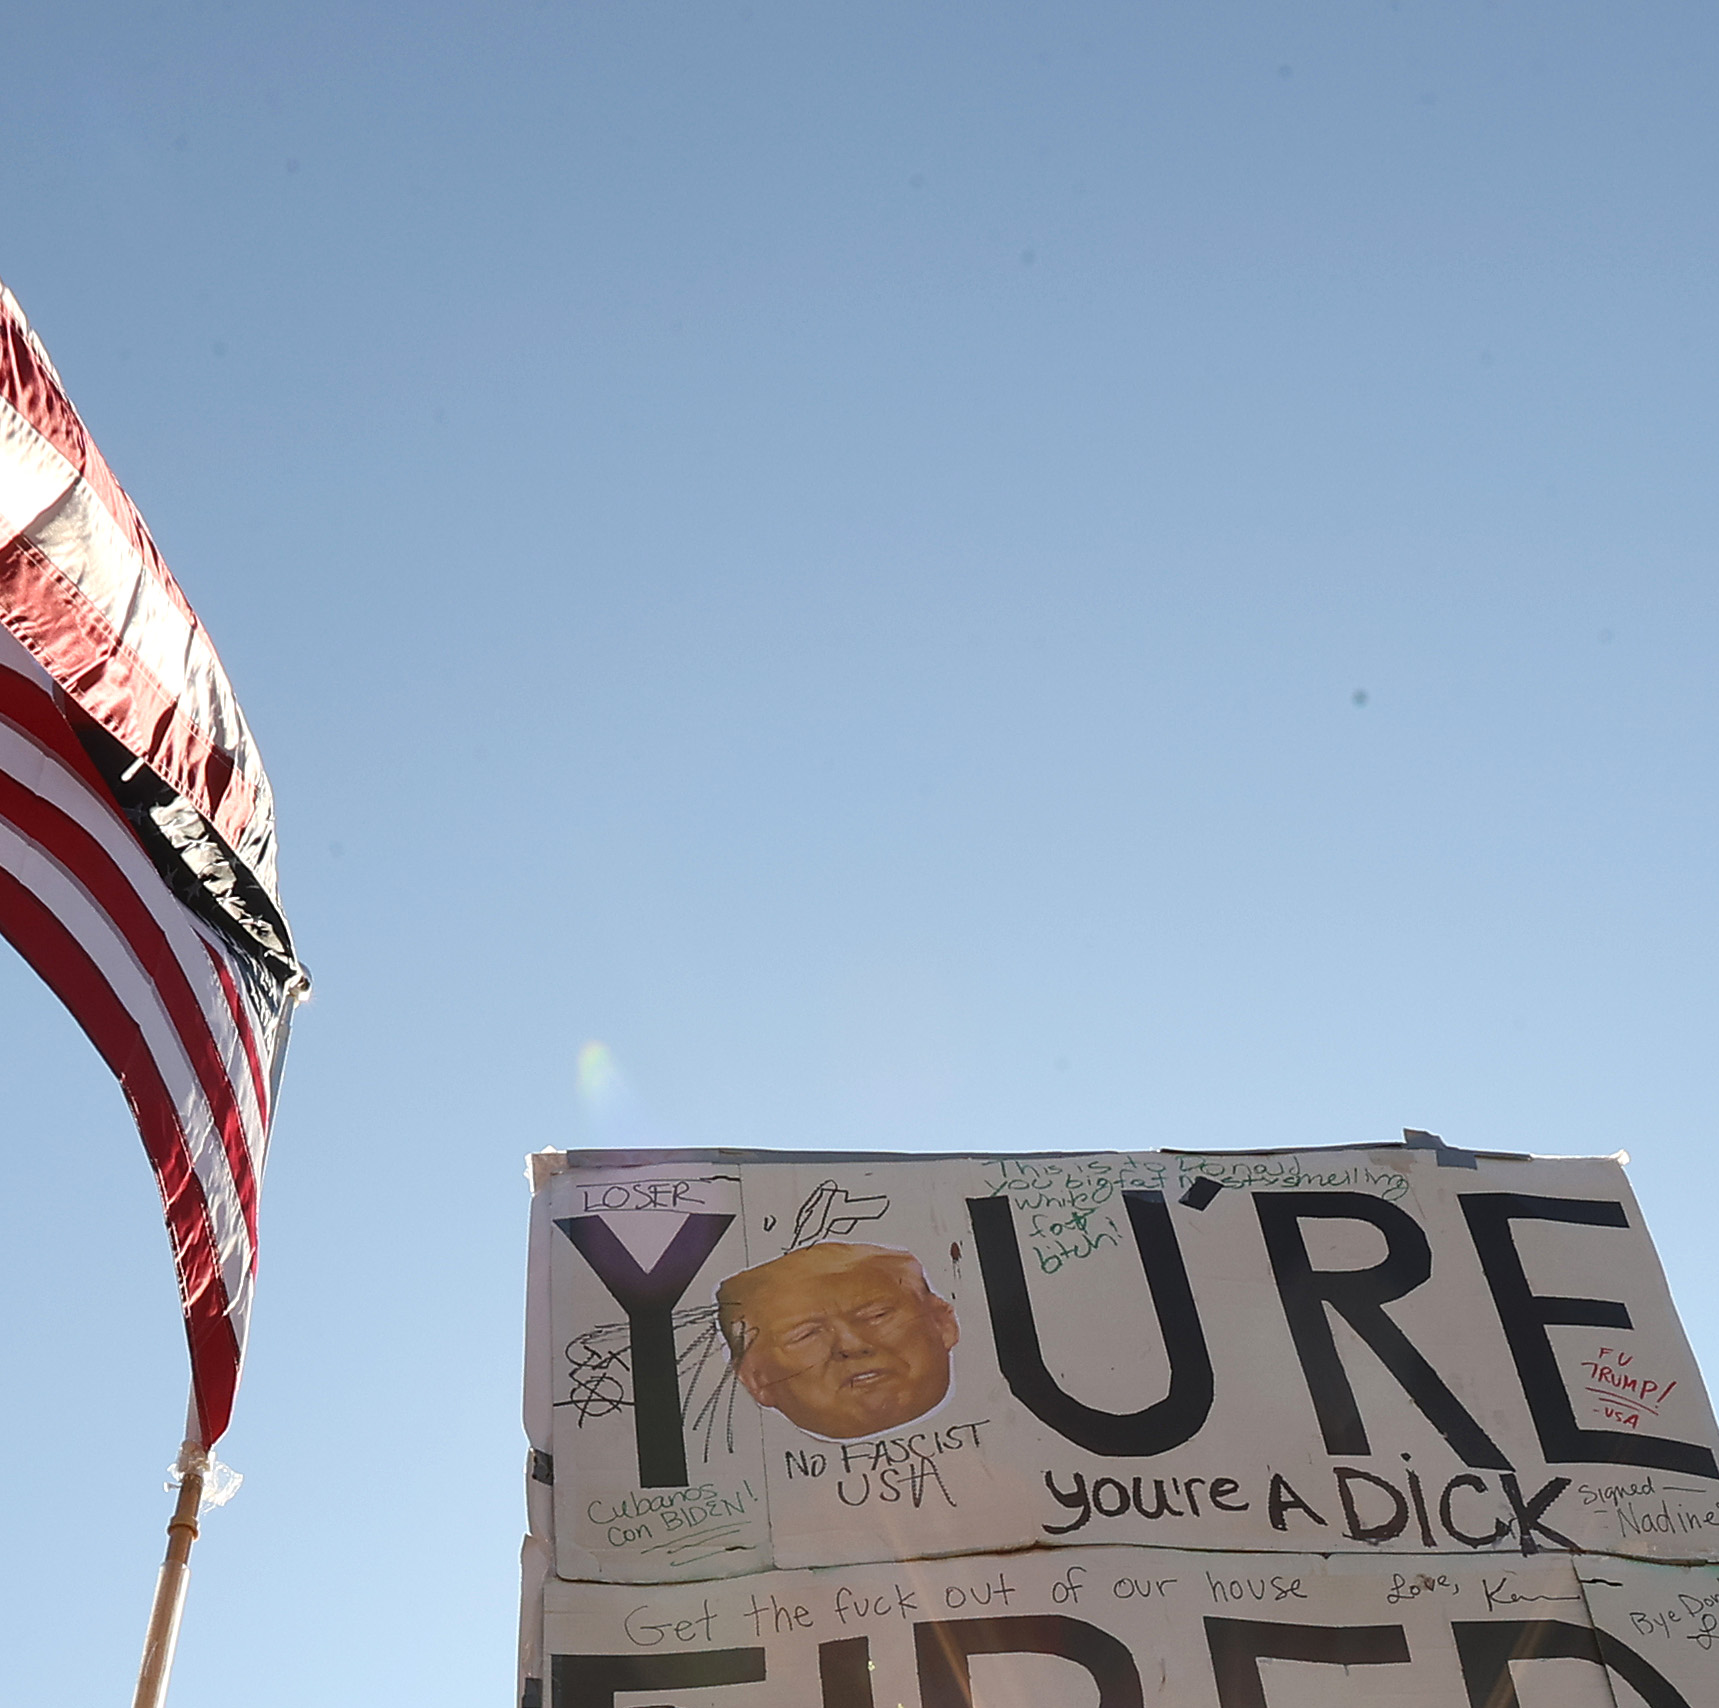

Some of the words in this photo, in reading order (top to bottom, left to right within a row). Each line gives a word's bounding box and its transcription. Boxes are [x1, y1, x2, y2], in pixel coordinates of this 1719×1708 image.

[581, 1178, 704, 1213] LOSER
[786, 1449, 826, 1479] NO
[842, 1419, 992, 1470] FASCIST
[587, 1482, 720, 1522] Cubanos
[661, 1480, 759, 1529] BIDEN!
[837, 1463, 956, 1508] USA
[1267, 1466, 1327, 1531] A
[1334, 1452, 1585, 1557] DICK
[625, 1600, 718, 1647] Get
[750, 1595, 814, 1639] the
[834, 1585, 918, 1627] fuck
[945, 1583, 1016, 1610] out
[1052, 1566, 1087, 1603] of
[1112, 1576, 1178, 1601] our
[1205, 1570, 1308, 1604] house
